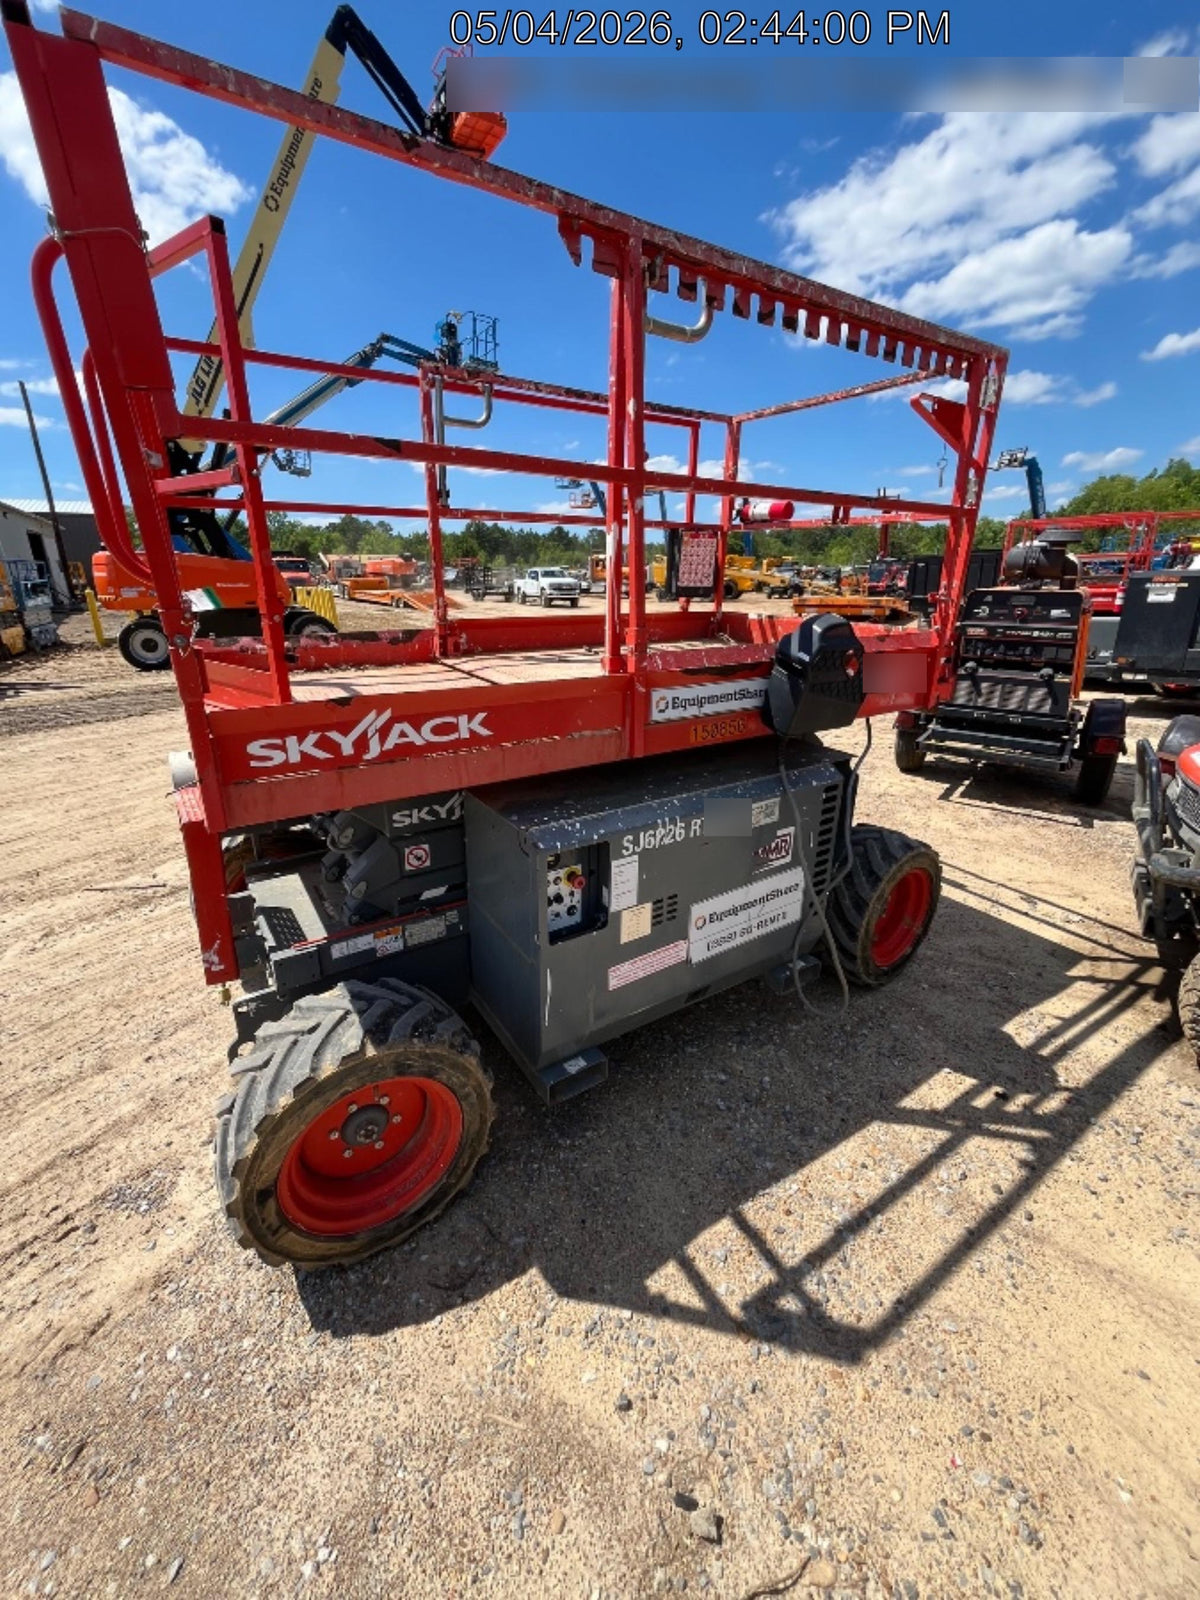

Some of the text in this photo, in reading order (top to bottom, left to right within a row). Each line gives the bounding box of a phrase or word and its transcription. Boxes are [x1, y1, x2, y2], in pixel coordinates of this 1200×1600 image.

[670, 687, 769, 712] EquipmentShar
[246, 708, 493, 768] SKYJACK
[392, 791, 464, 828] SKYJ
